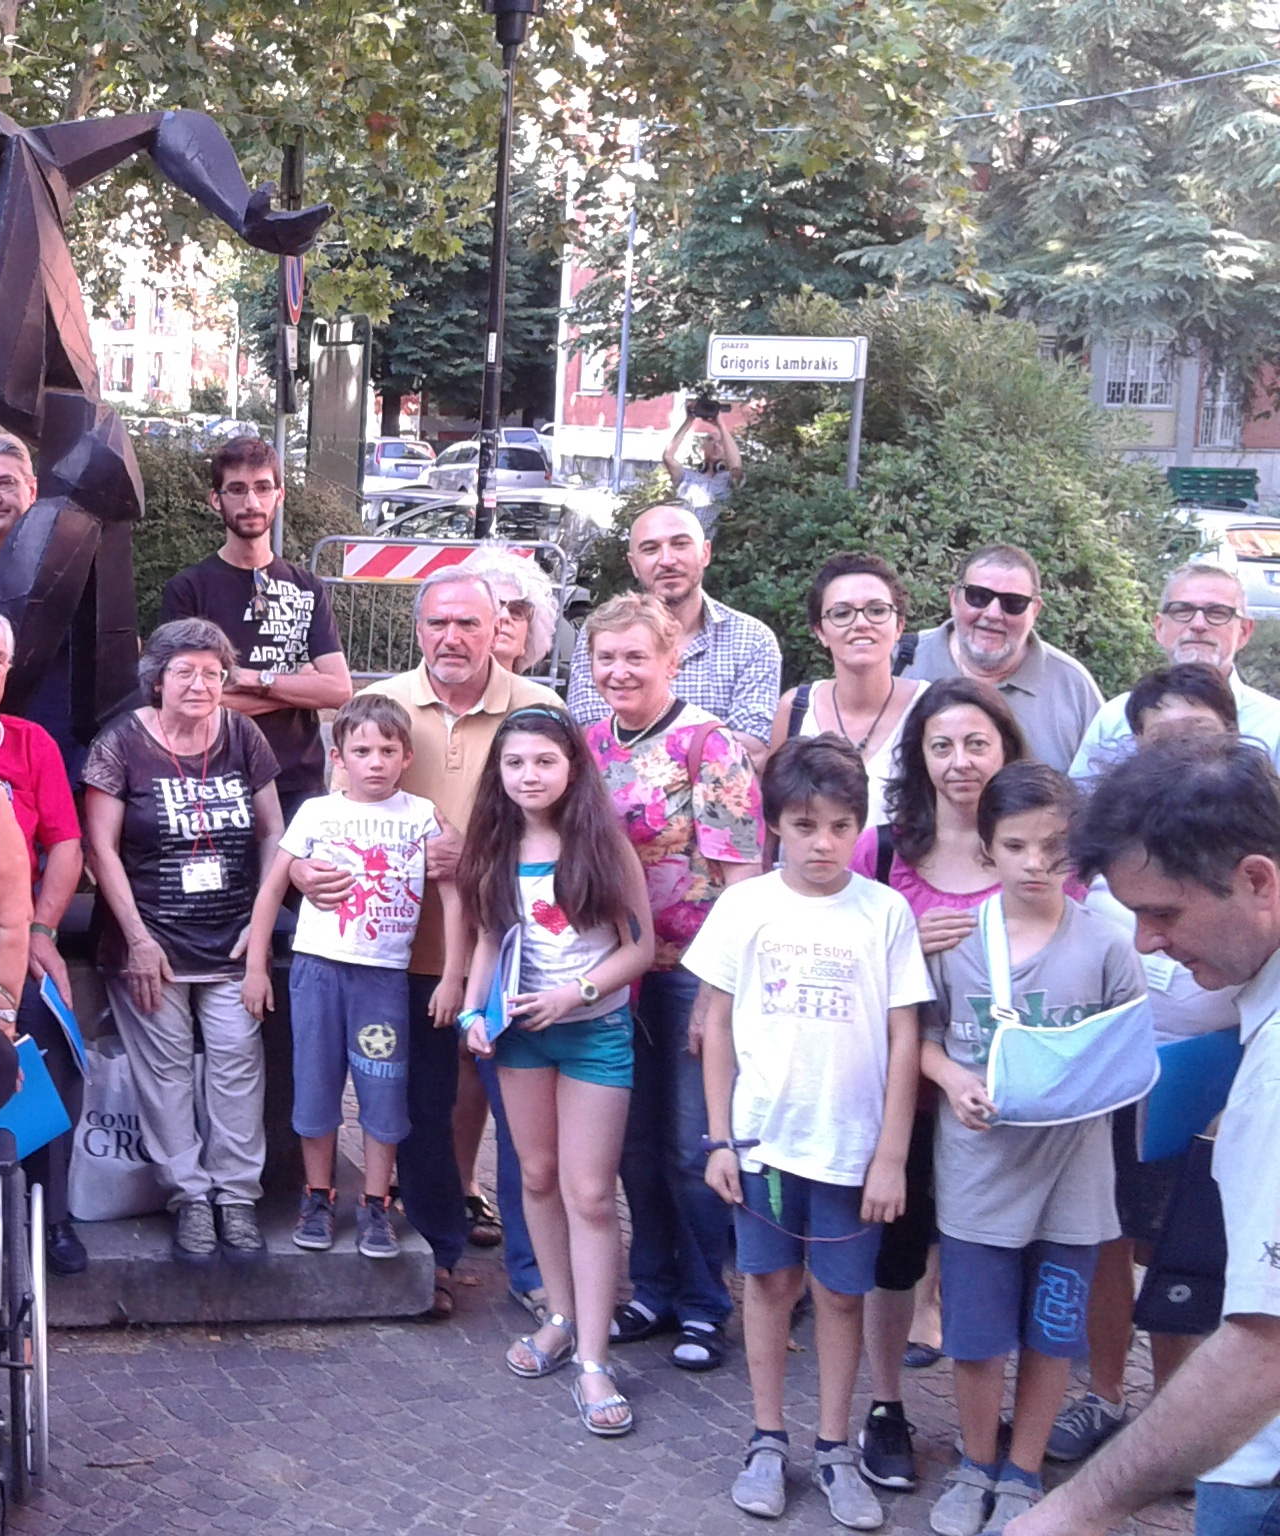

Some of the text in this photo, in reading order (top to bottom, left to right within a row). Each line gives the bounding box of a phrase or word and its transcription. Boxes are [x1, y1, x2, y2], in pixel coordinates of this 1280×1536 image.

[721, 342, 750, 350] piazza
[720, 354, 838, 372] Grigoris Lambrakis
[166, 796, 251, 840] hard
